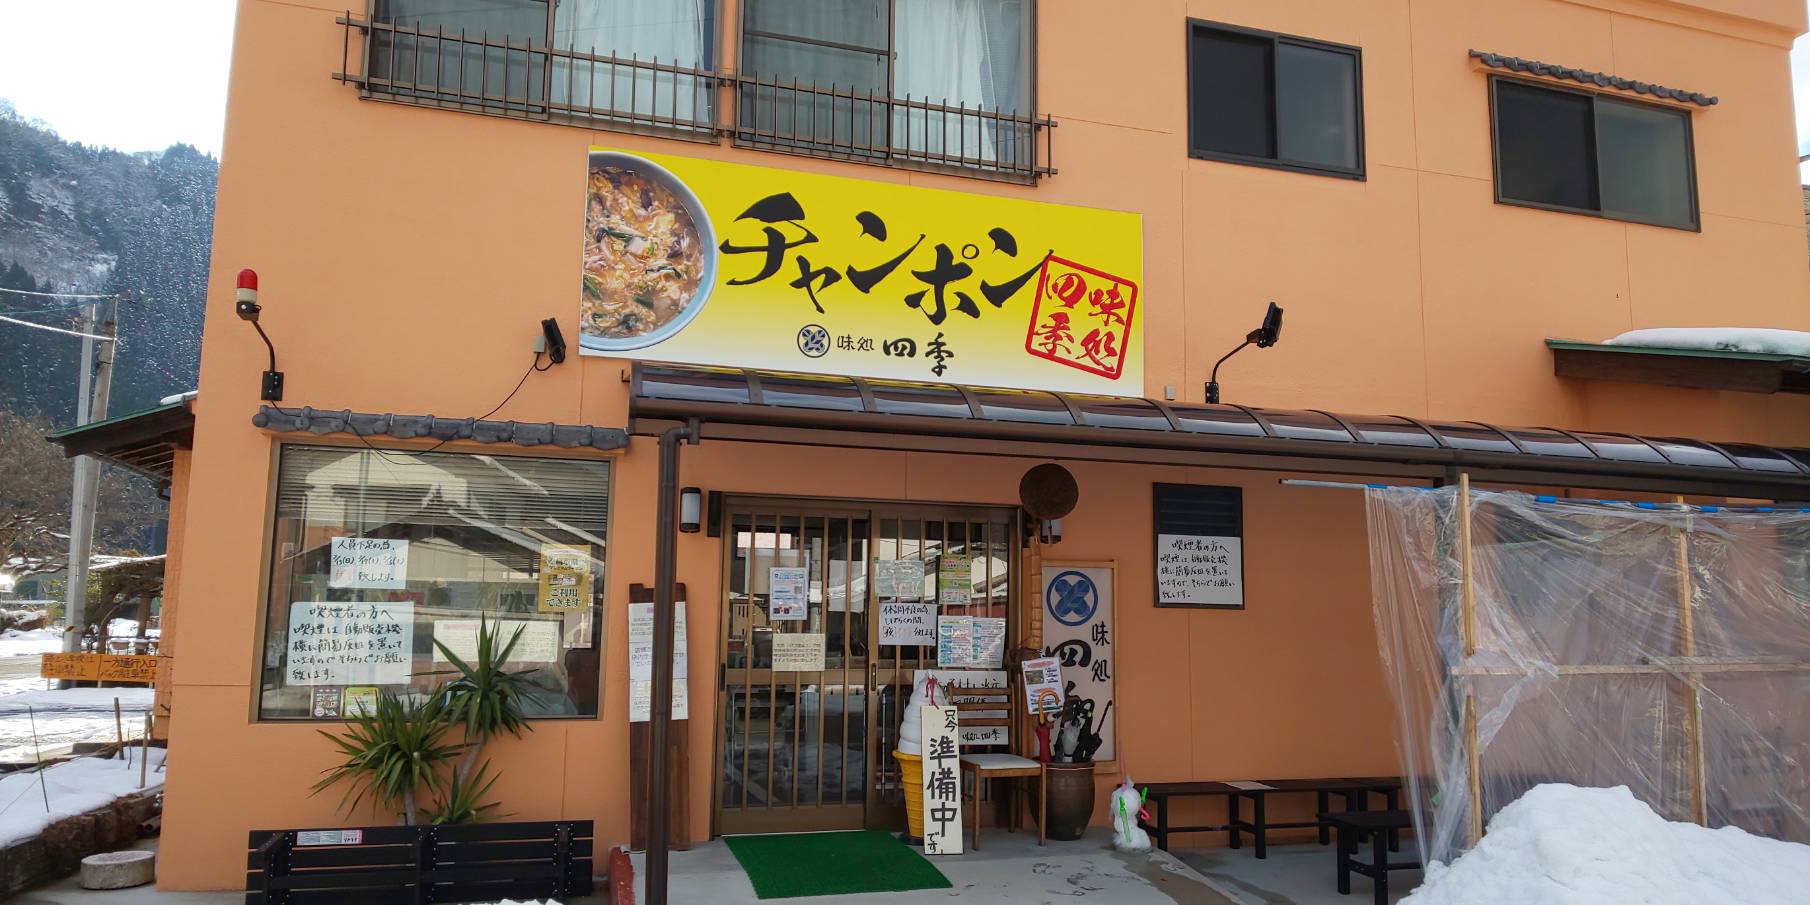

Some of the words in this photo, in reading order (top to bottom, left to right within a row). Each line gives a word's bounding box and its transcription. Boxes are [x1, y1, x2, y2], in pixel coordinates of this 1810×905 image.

[719, 191, 1054, 325] チャンポン
[1034, 270, 1087, 354] 四季
[1077, 280, 1128, 373] 味処
[836, 333, 875, 353] 味処
[882, 331, 955, 376] 四季
[309, 604, 394, 621] 喫煙者の方へ
[546, 598, 581, 607] できます
[1091, 621, 1111, 682] 味処
[944, 709, 957, 732] 只今
[926, 735, 958, 837] 準備中
[927, 831, 940, 854] です
